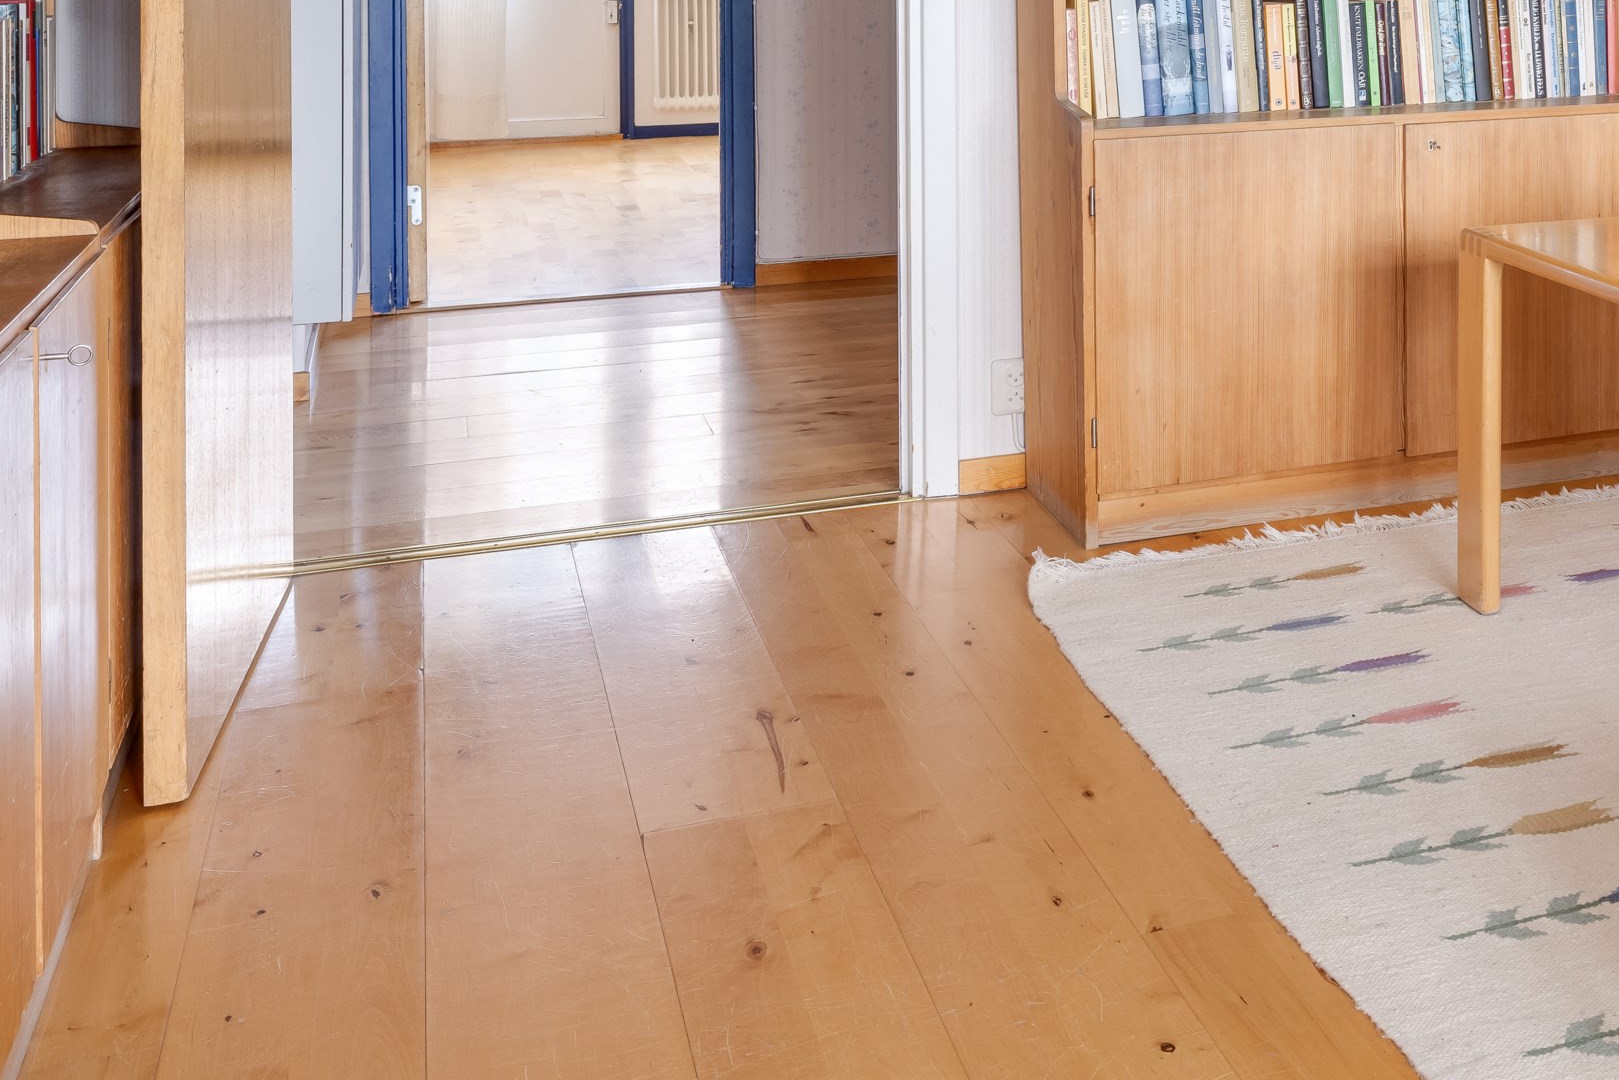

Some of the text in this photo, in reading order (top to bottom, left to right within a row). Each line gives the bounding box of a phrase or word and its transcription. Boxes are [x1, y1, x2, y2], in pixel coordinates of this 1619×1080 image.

[1163, 10, 1171, 23] sig
[1165, 25, 1176, 52] aldrig
[1240, 19, 1250, 63] Ferrante
[1355, 25, 1363, 69] FALDBAKKEN
[1196, 61, 1206, 79] land
[1534, 50, 1543, 78] LUDWIG
